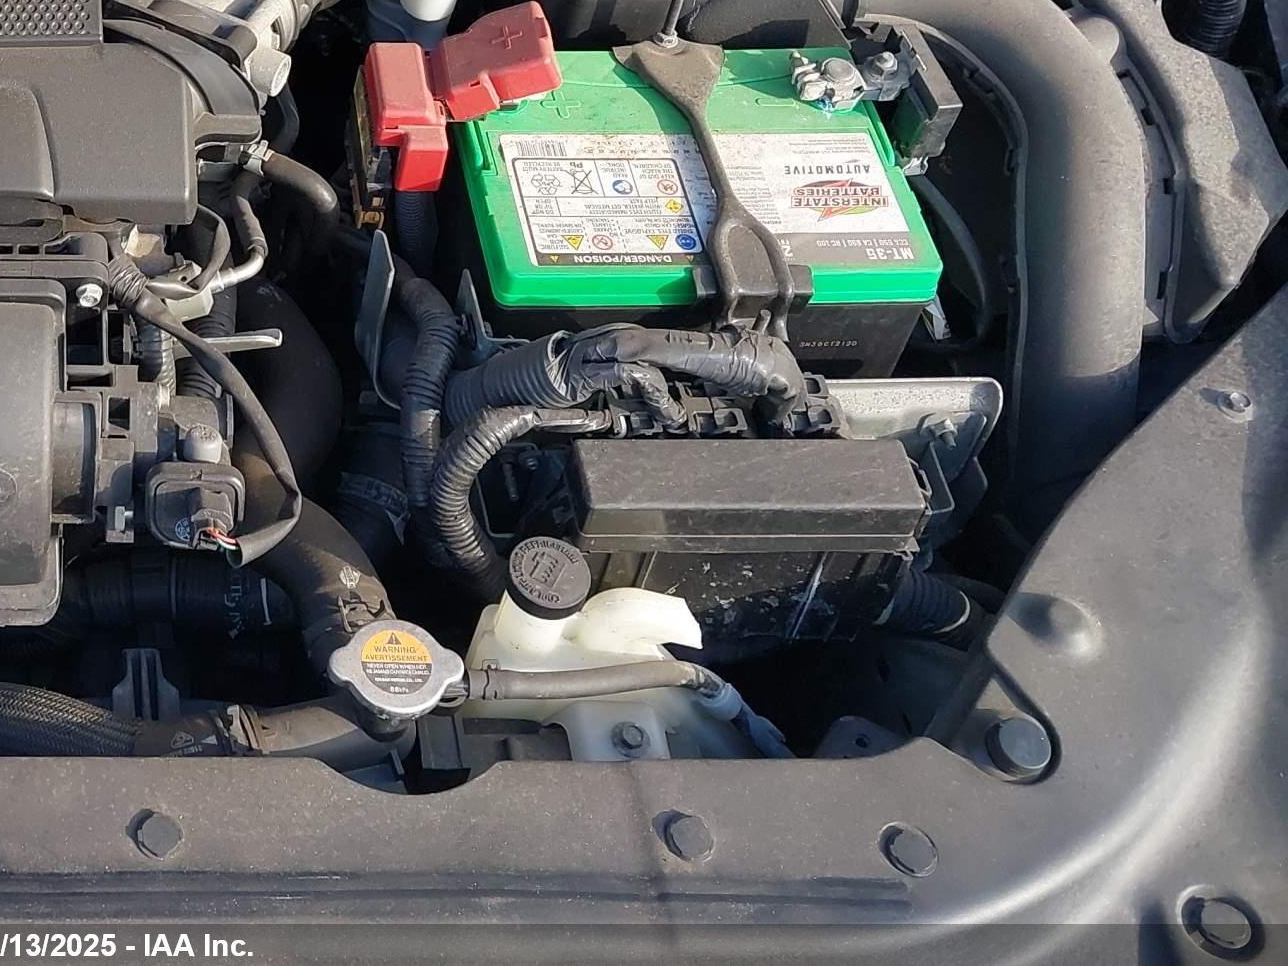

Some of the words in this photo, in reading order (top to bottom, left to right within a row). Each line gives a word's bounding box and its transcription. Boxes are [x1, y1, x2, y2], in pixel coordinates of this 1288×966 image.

[784, 165, 870, 175] AUTOMOTIVE
[796, 187, 880, 196] BATTERIES
[794, 198, 887, 207] INTERSTATE
[865, 247, 914, 259] MT-35
